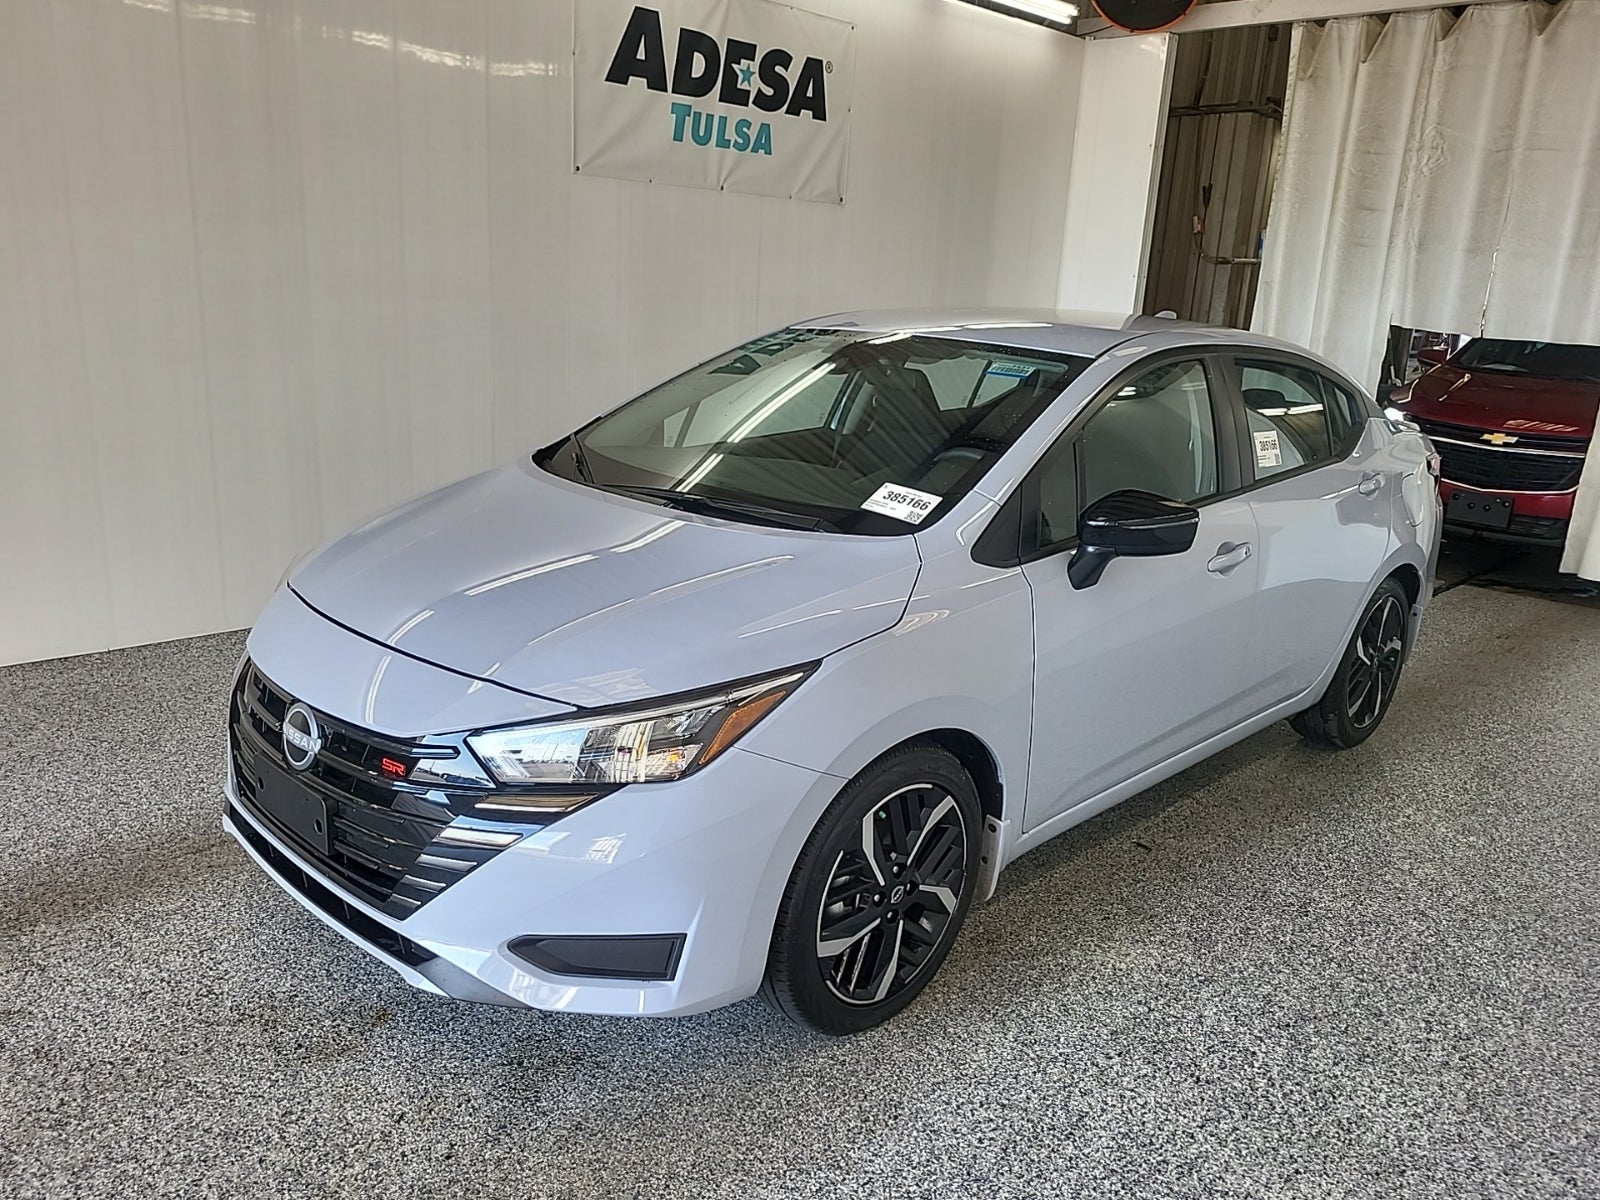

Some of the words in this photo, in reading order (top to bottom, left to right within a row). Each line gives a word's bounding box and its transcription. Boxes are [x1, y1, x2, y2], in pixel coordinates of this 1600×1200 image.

[604, 6, 827, 122] ADESA
[670, 102, 772, 156] TULSA
[882, 490, 932, 511] 385166
[382, 757, 406, 776] SR
